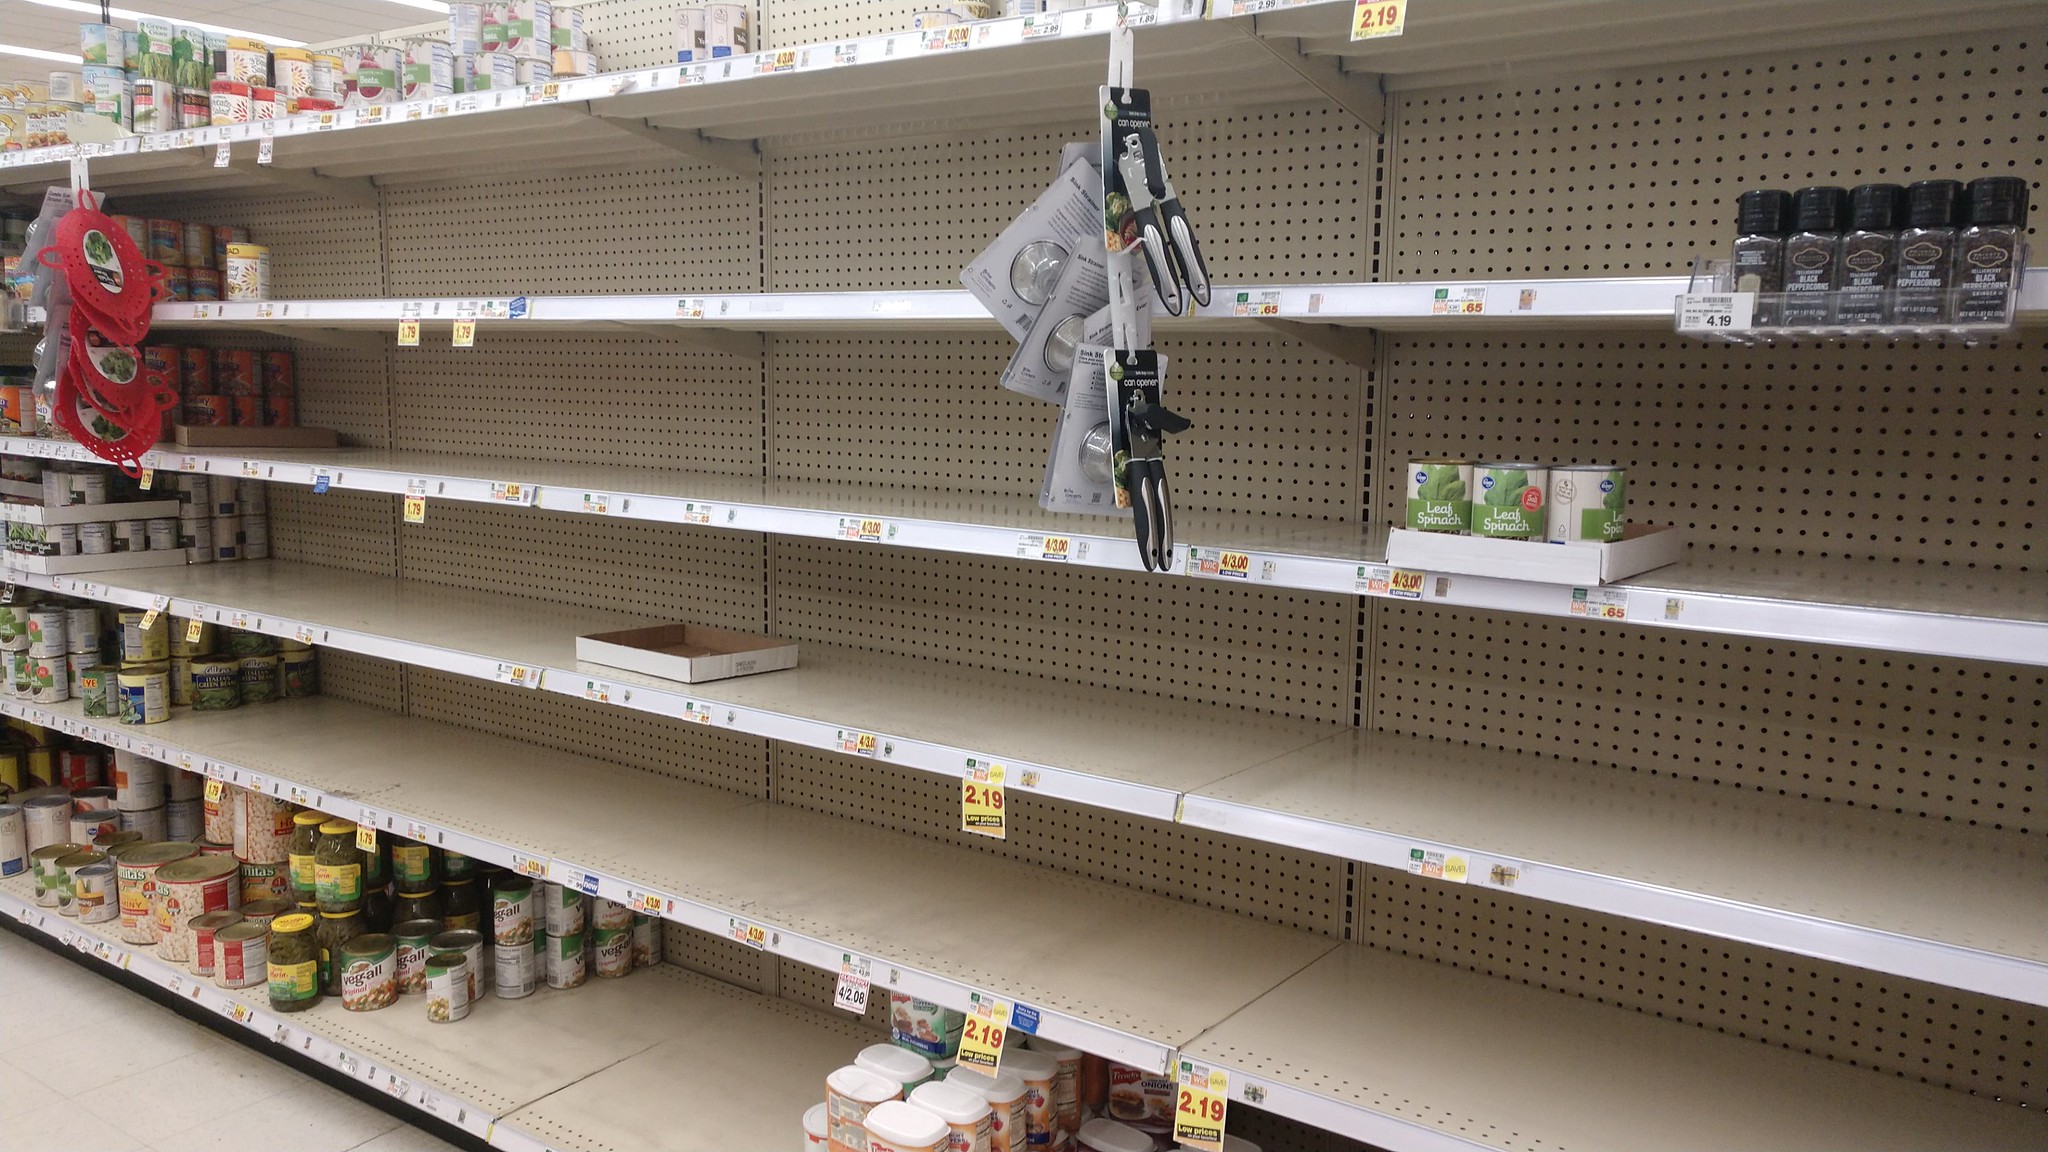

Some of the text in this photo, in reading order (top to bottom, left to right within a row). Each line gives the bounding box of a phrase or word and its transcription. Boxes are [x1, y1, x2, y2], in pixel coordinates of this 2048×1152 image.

[1258, 0, 1276, 9] 2.99
[1139, 14, 1154, 24] 1.89
[1361, 5, 1397, 29] 2.19
[1043, 24, 1059, 34] 2.99
[947, 27, 968, 43] 4/3.00
[1118, 119, 1129, 127] can
[1897, 278, 1941, 287] PEPPERCORNS
[1975, 274, 1996, 282] BLACK
[1261, 305, 1278, 314] .65
[1462, 303, 1482, 313] .65
[1707, 315, 1732, 326] 4.19
[402, 326, 415, 337] 1.79
[456, 326, 470, 338] 1.79
[1080, 349, 1093, 357] Sink
[1124, 379, 1158, 388] can opener
[407, 503, 421, 516] 1.79
[1427, 502, 1453, 517] Leaf
[1494, 508, 1521, 522] Leaf
[1417, 512, 1462, 528] Spinach
[1613, 511, 1623, 522] Le
[862, 521, 880, 534] 4/3.00
[1484, 518, 1530, 534] Spinach
[1045, 538, 1068, 552] 4/3.00
[1222, 554, 1248, 569] 4/3.00
[1392, 572, 1422, 589] 4/3.00
[1602, 607, 1625, 618] .65
[189, 625, 201, 636] 1.79
[82, 679, 97, 688] EYE
[989, 771, 1004, 779] SAVE!
[207, 785, 219, 796] 1.79
[965, 785, 1003, 809] 2.19
[967, 815, 1000, 825] Low prices
[359, 833, 372, 845] 1.79
[120, 868, 145, 880] nita's
[243, 865, 274, 876] nita's
[1426, 865, 1466, 873] WIC SAVE!
[584, 881, 598, 891] new
[646, 896, 660, 909] 4/3.00
[749, 927, 764, 942] 4/3.00
[343, 985, 367, 995] Original
[839, 990, 864, 1005] 4/2.08
[994, 1008, 1007, 1017] SAVE!
[964, 1019, 1003, 1048] 2.19
[961, 1049, 994, 1062] Low prices
[1141, 1081, 1173, 1090] ONIONS
[1194, 1077, 1227, 1086] WIC SAVE!
[1179, 1091, 1224, 1122] 2.19
[1179, 1125, 1217, 1137] Low prices
